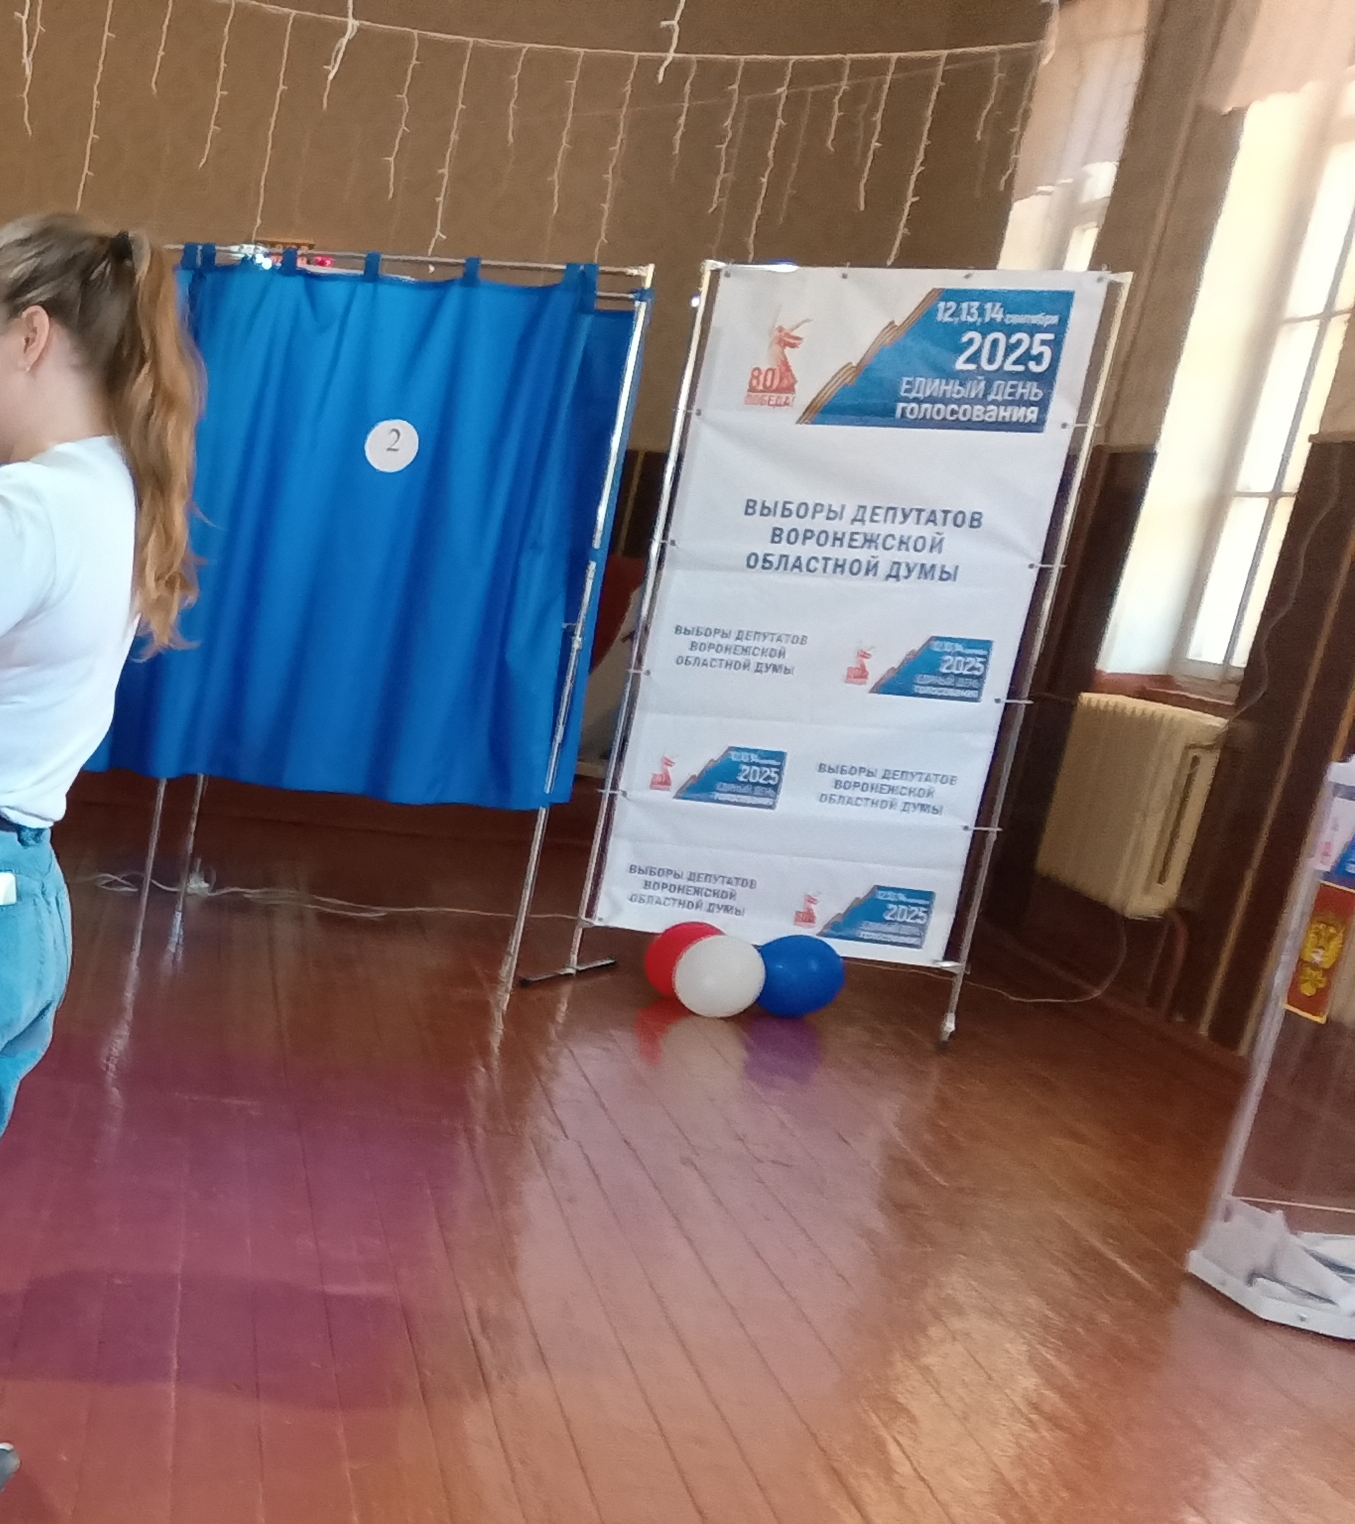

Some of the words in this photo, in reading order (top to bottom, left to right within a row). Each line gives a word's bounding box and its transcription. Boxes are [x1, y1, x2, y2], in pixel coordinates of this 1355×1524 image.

[937, 301, 1004, 325] 12,13,14
[954, 331, 1055, 373] 2025
[748, 366, 776, 391] 80
[899, 375, 985, 400] ЕДИНЫЙ
[986, 378, 1044, 402] ДЕНЬ
[895, 402, 1039, 424] голосования
[386, 428, 401, 452] 2
[744, 498, 846, 522] ВЫБОРЫ
[850, 504, 984, 530] ДЕПУТАТОВ
[769, 526, 945, 555] ВОРОНЕЖСКОЙ
[745, 552, 880, 578] ОБЛАСТНОЙ
[885, 560, 959, 583] ДУМЫ
[673, 624, 732, 640] ВЫБОРЫ
[735, 629, 808, 646] ДЕПУТАТОВ
[689, 641, 786, 660] ВОРОНЕЖСКОЙ
[675, 655, 751, 672] ОБЛАСТНОЙ
[754, 661, 795, 676] ДУМЫ
[940, 655, 987, 676] 2025
[736, 764, 780, 786] 2025
[817, 762, 878, 778] ВЫБОРЫ
[881, 768, 958, 786] ДЕПУТАТОВ
[833, 779, 936, 799] ВОРОНЕЖСКОЙ
[819, 792, 898, 811] ОБЛАСТНОЙ
[900, 801, 944, 816] ДУМЫ
[628, 864, 684, 880] ВЫБОРЫ
[686, 871, 758, 890] ДЕПУТАТОВ
[643, 880, 738, 901] ВОРОНЕЖСКОЙ
[628, 893, 704, 911] ОБЛАСТНОЙ
[706, 902, 746, 917] ДУМЫ
[883, 903, 929, 924] 2025
